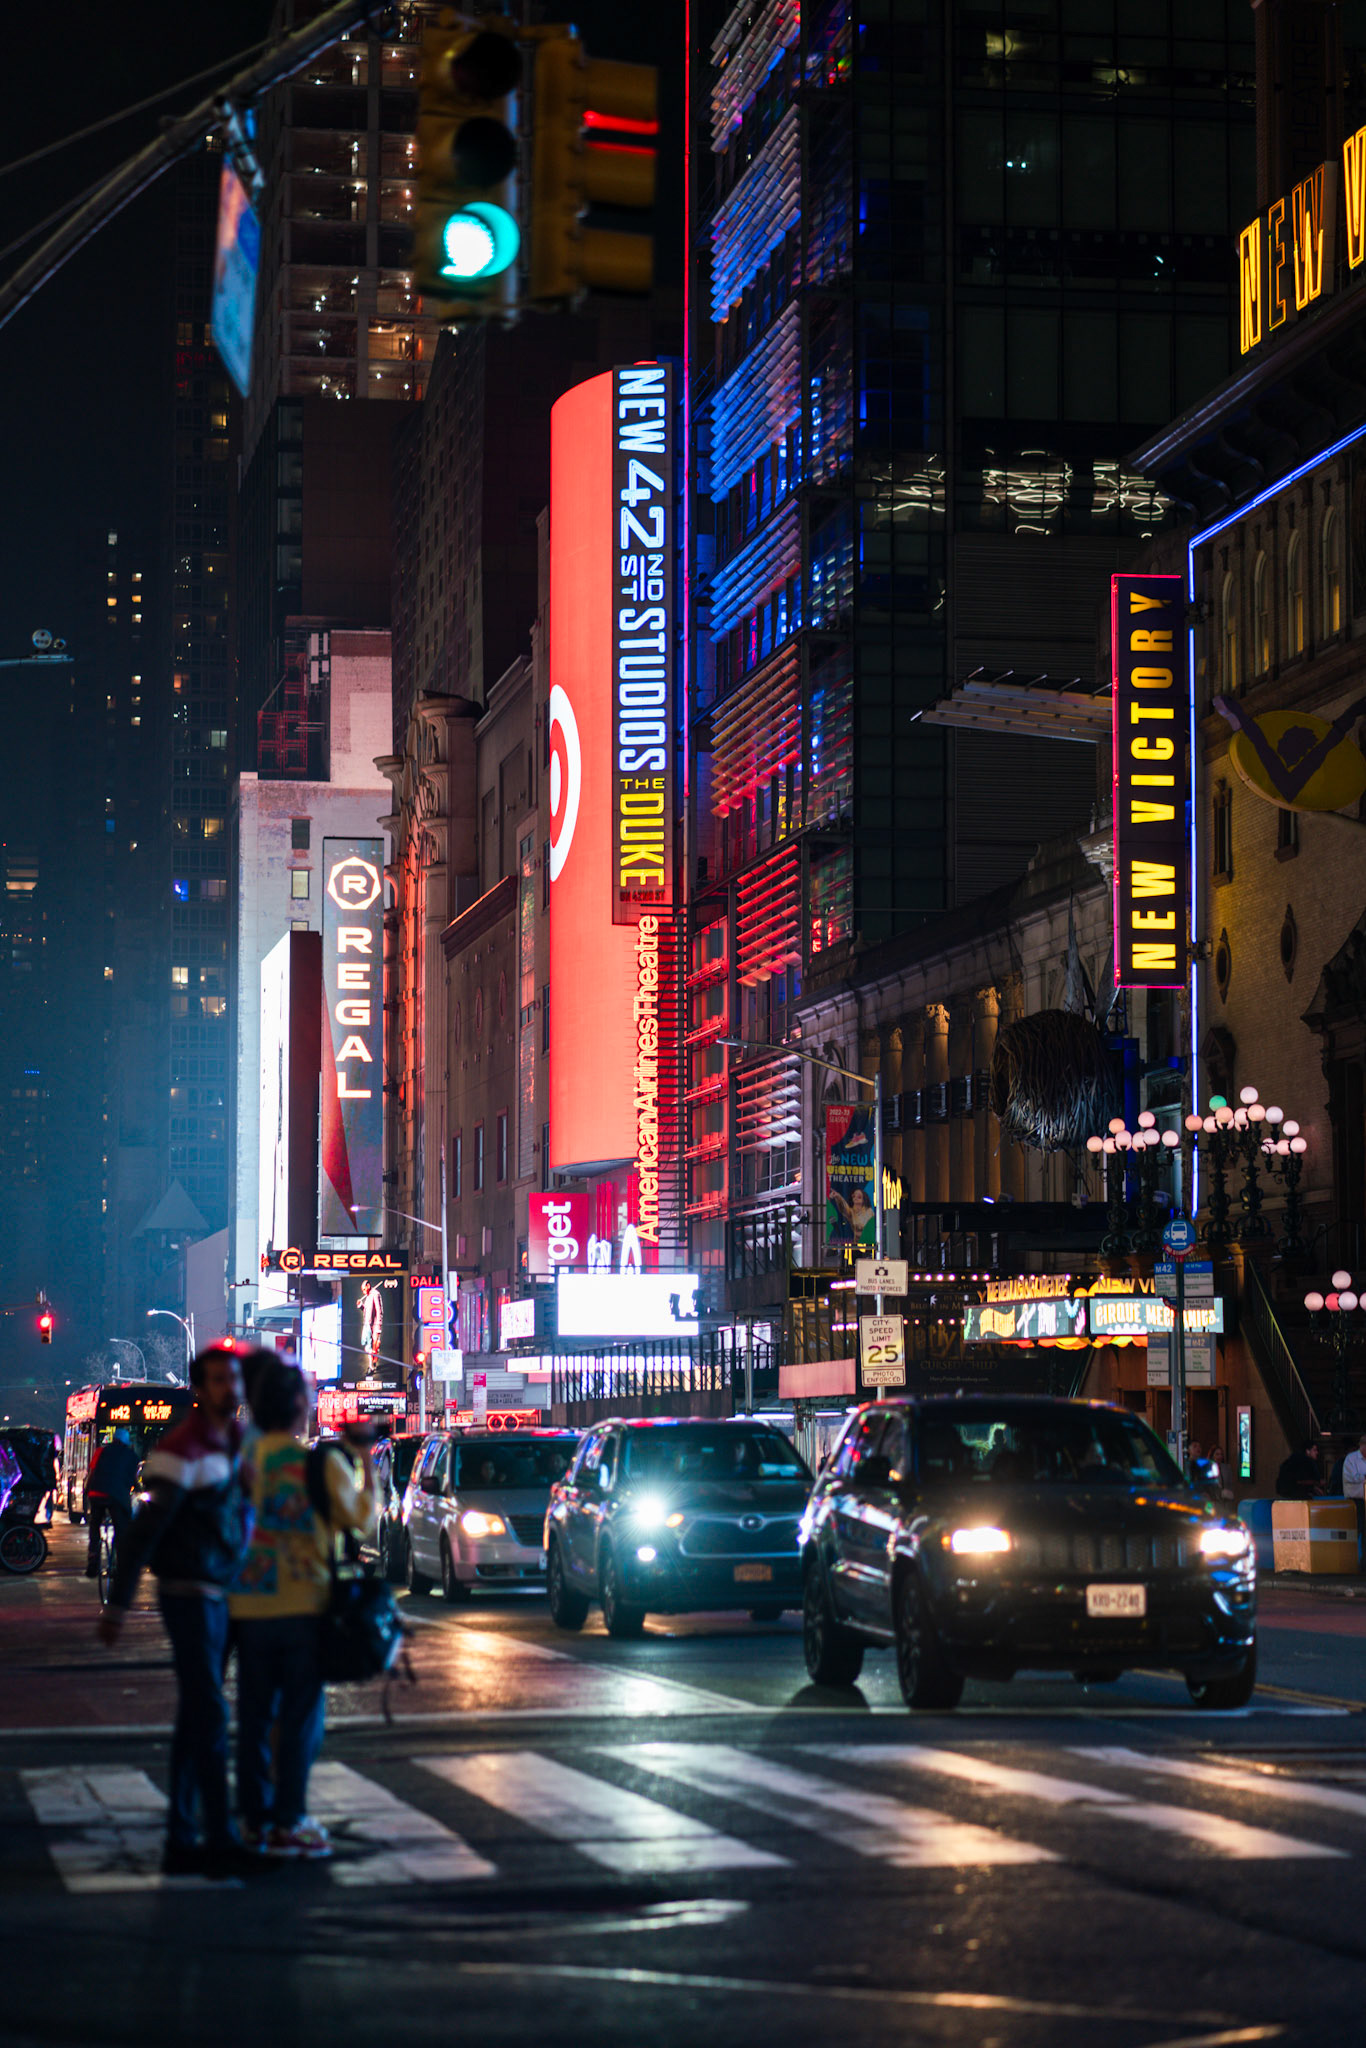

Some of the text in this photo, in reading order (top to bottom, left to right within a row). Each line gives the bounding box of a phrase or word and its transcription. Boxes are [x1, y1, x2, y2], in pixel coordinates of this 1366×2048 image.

[1240, 163, 1324, 355] NEW
[618, 368, 666, 454] NEW
[618, 607, 667, 771] STUDIOS
[1130, 591, 1177, 970] NEW VICTORY
[619, 777, 665, 887] THE DUKE
[334, 926, 374, 1099] REGAL
[841, 1153, 868, 1166] NEW
[828, 1174, 865, 1183] THEATER
[313, 1254, 402, 1268] REGAL
[1155, 1264, 1172, 1273] M42
[1097, 1278, 1135, 1293] NEW
[1095, 1302, 1142, 1327] CIRQUE
[867, 1344, 899, 1363] 25
[110, 1404, 131, 1420] M42
[320, 1398, 340, 1409] FIVE
